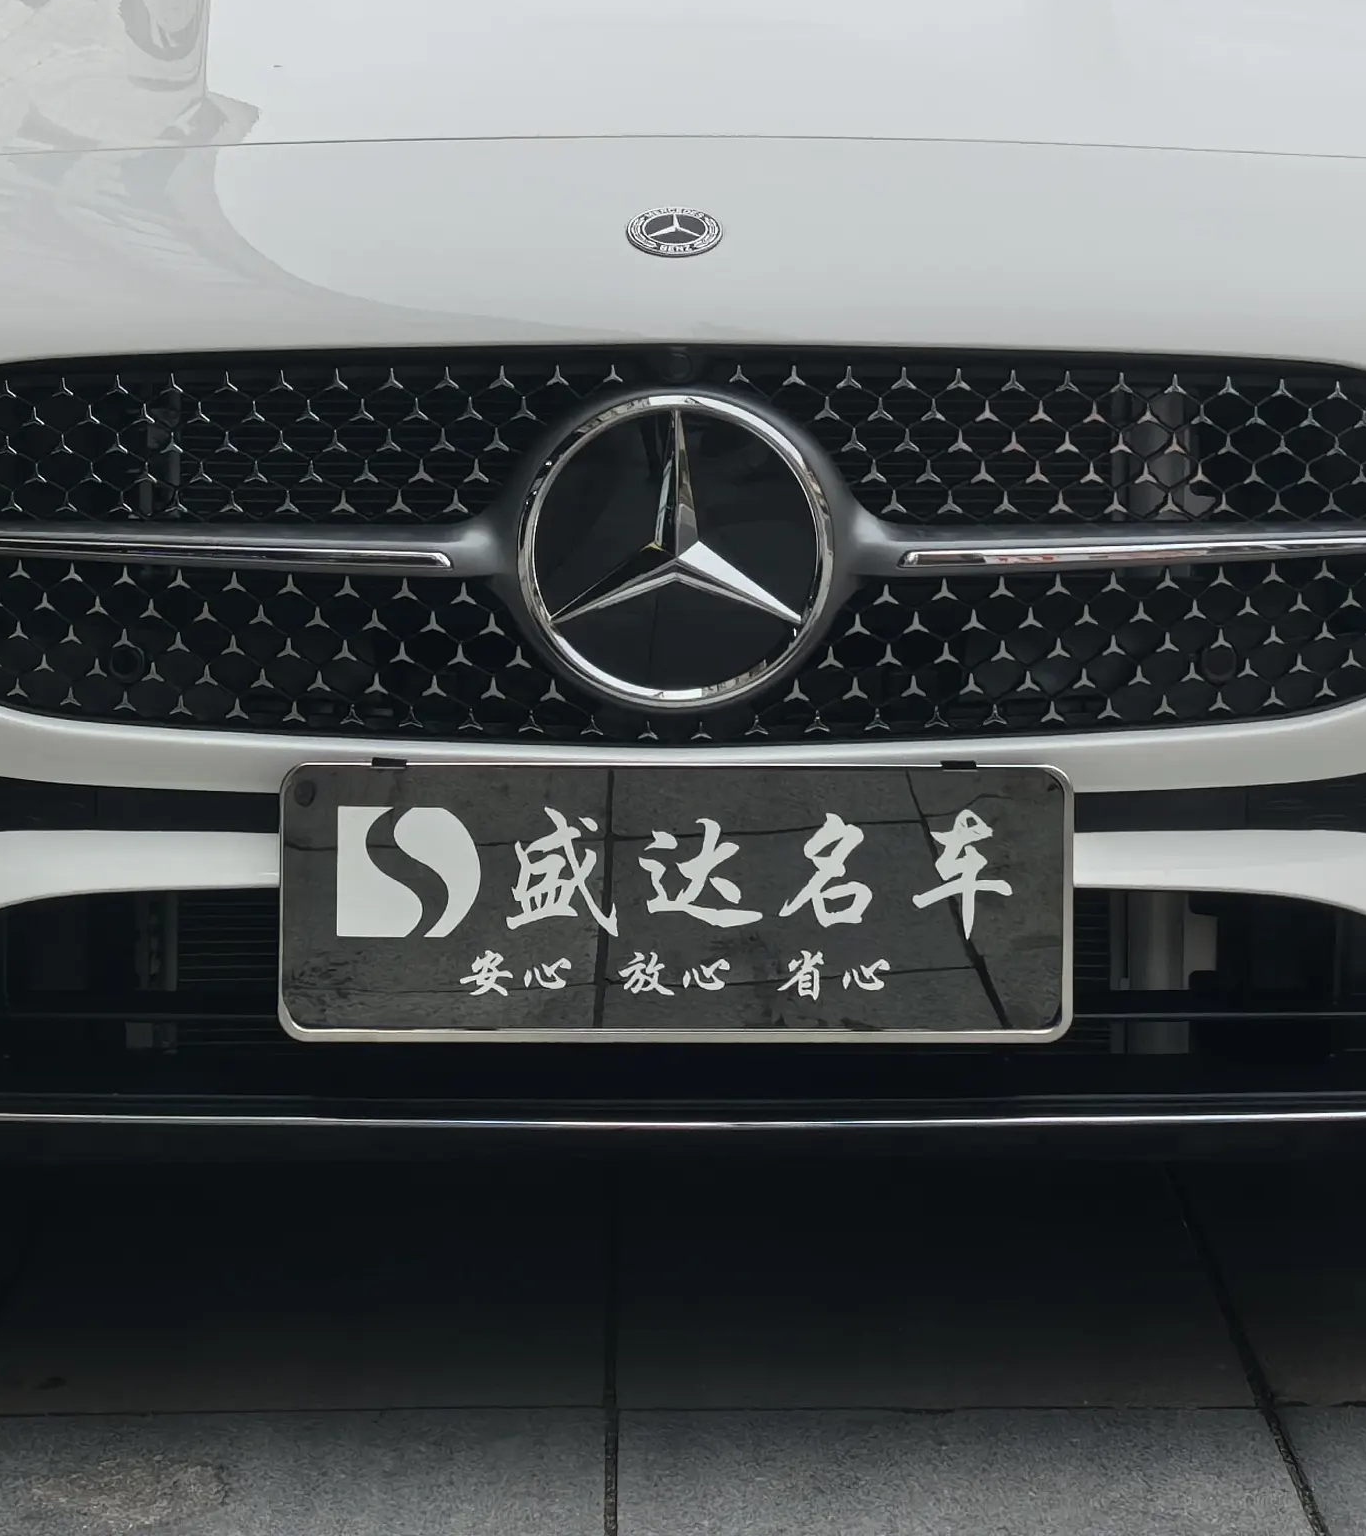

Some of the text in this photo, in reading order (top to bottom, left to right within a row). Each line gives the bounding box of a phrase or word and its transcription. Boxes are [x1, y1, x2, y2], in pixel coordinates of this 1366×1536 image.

[505, 805, 1015, 939] 盛达名车
[459, 950, 892, 1002] 安心 放心 省心
